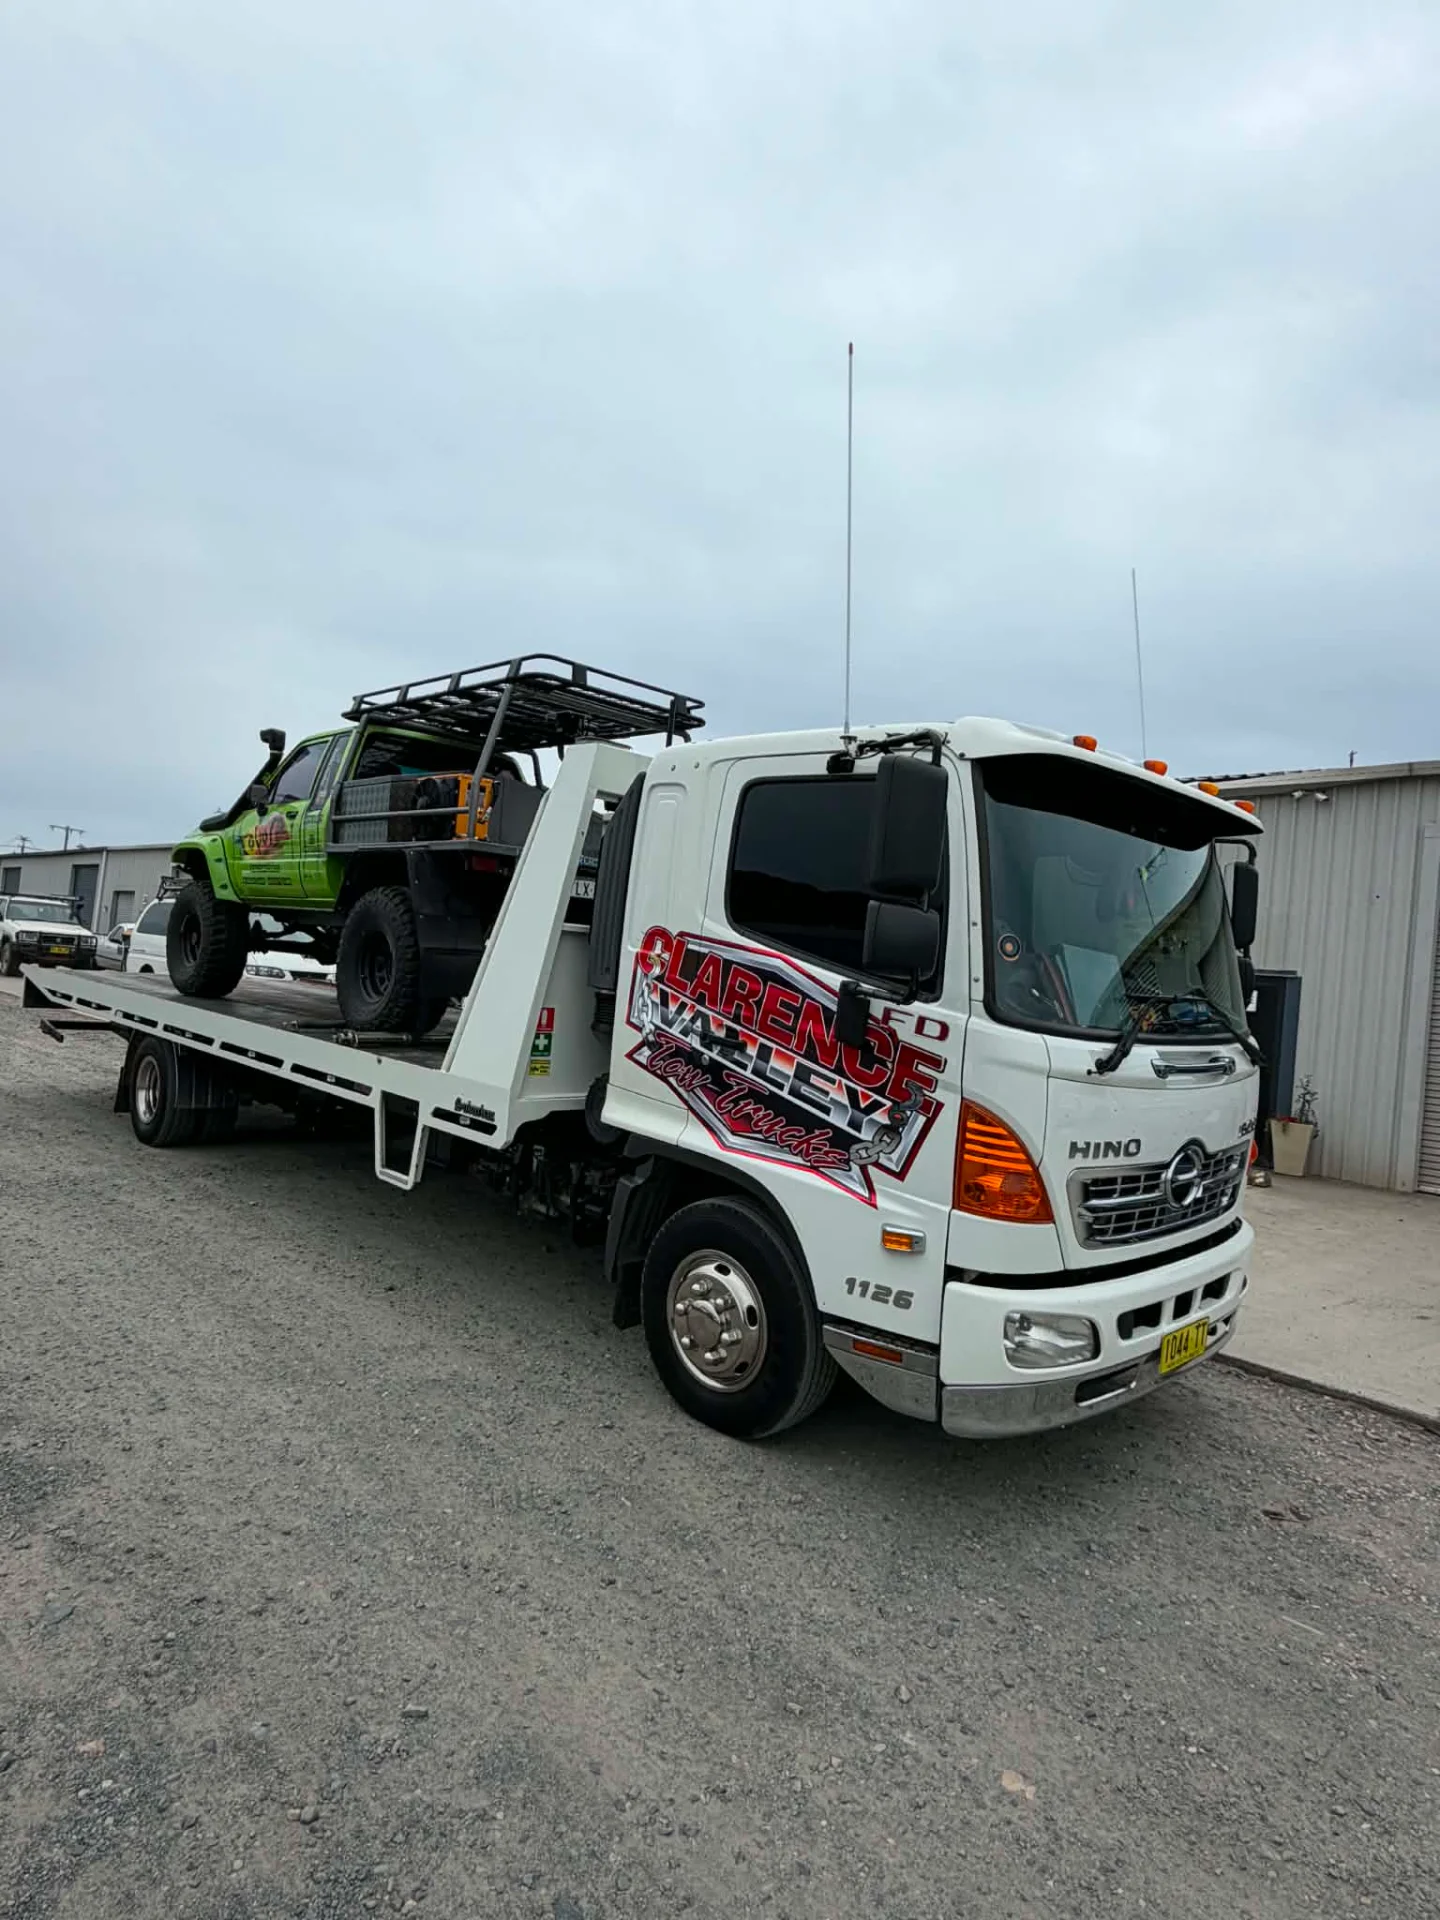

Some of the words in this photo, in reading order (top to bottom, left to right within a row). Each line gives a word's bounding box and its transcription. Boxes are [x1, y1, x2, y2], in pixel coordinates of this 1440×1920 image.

[638, 925, 948, 1117] CLARENCE
[647, 1031, 712, 1092] Tow
[714, 1070, 850, 1170] Trucks
[1068, 1139, 1142, 1159] HINO
[845, 1277, 914, 1310] 1126
[1165, 1328, 1190, 1363] 1044
